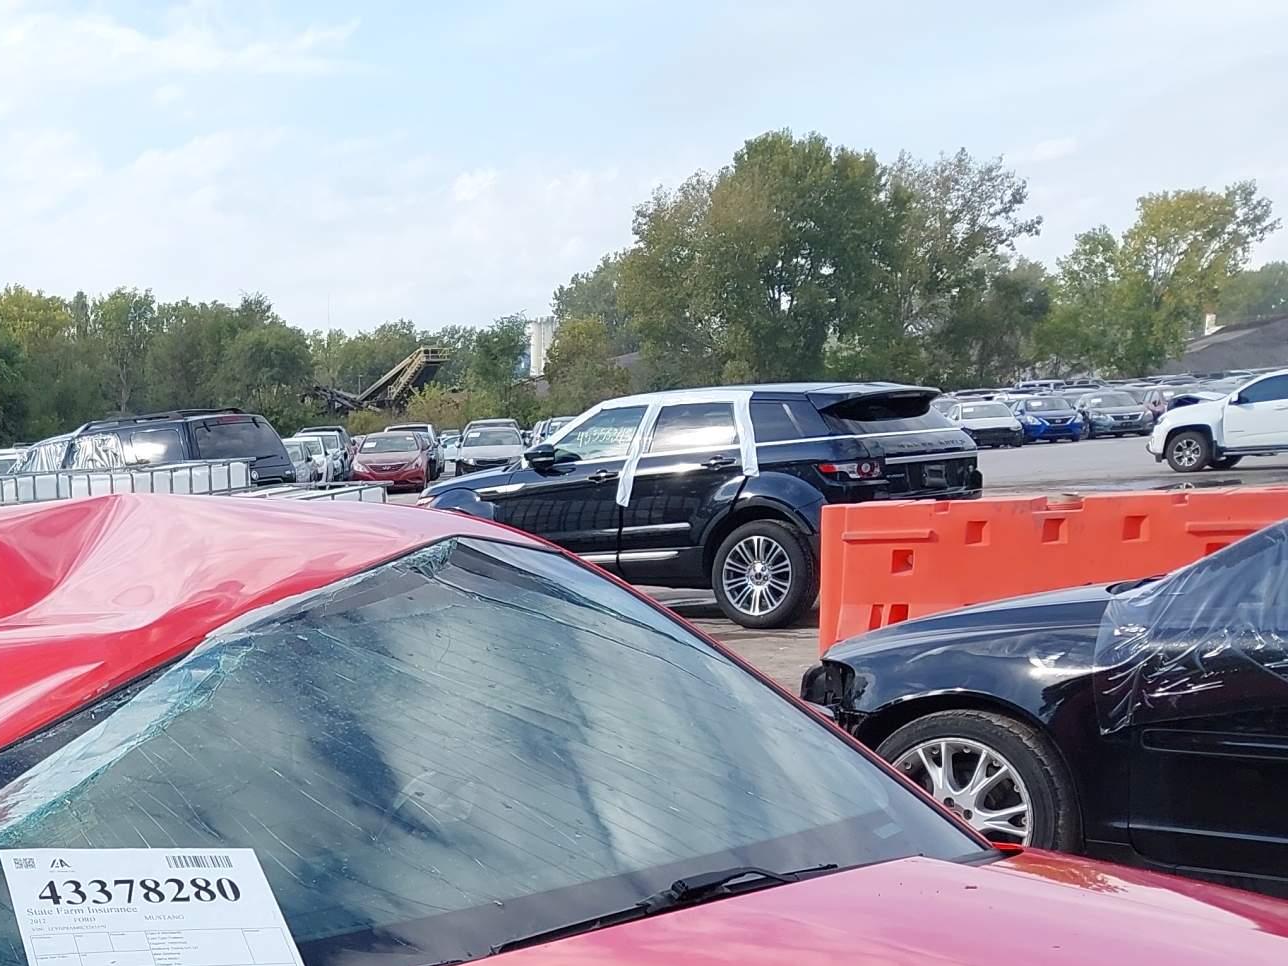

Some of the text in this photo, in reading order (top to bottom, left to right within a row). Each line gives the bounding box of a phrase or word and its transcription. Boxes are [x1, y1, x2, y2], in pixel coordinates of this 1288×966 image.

[38, 877, 242, 905] 43378280
[26, 905, 138, 916] State Farm Insurance
[143, 914, 185, 922] MUSTANG
